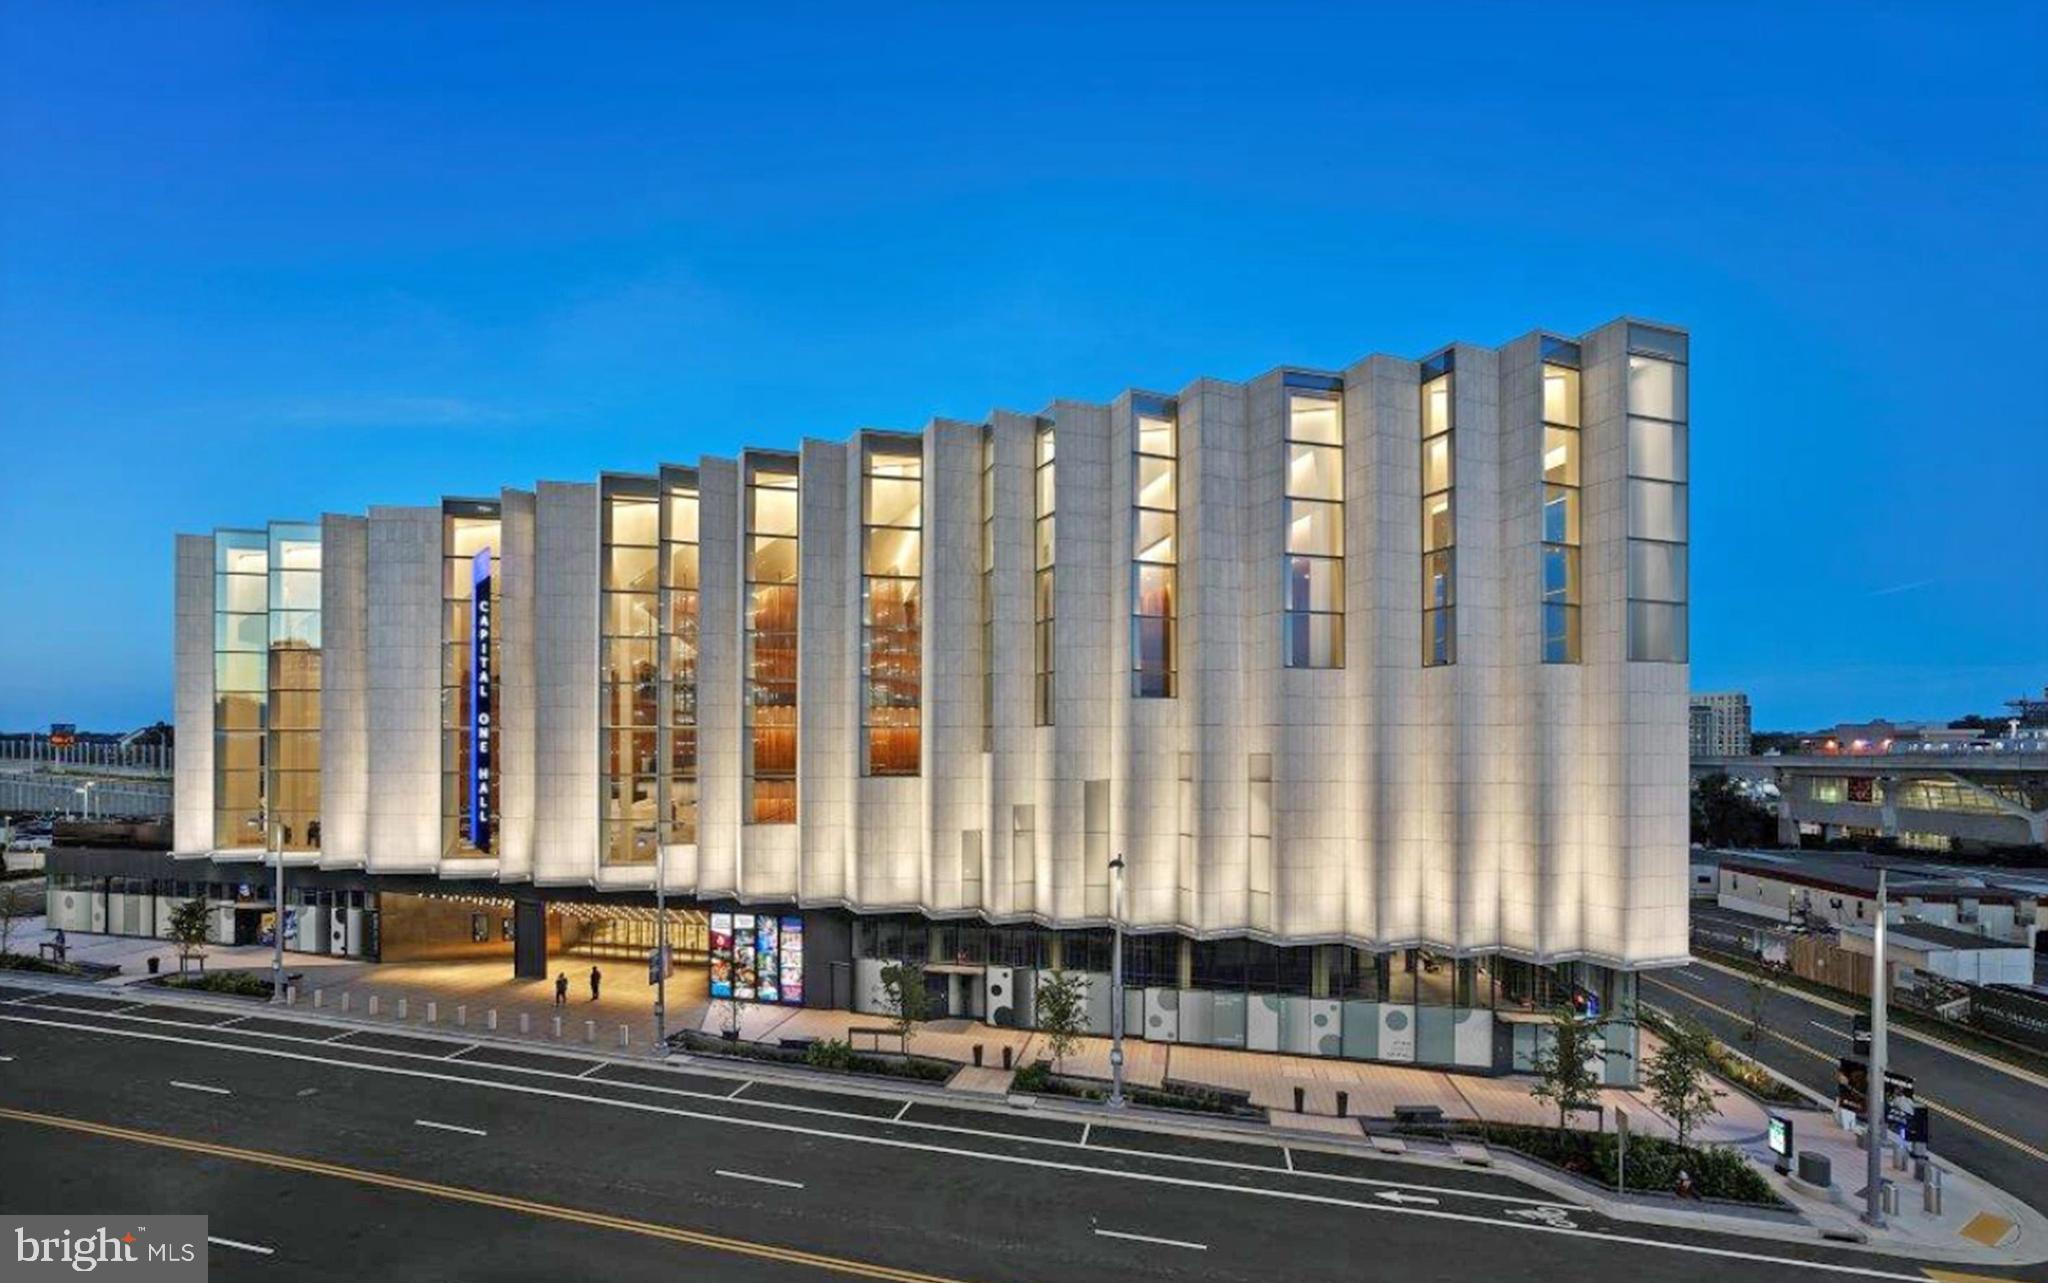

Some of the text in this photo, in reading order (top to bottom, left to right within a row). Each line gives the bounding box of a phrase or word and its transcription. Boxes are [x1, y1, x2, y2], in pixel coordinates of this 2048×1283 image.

[478, 600, 490, 821] CAPITAL ONE HALL
